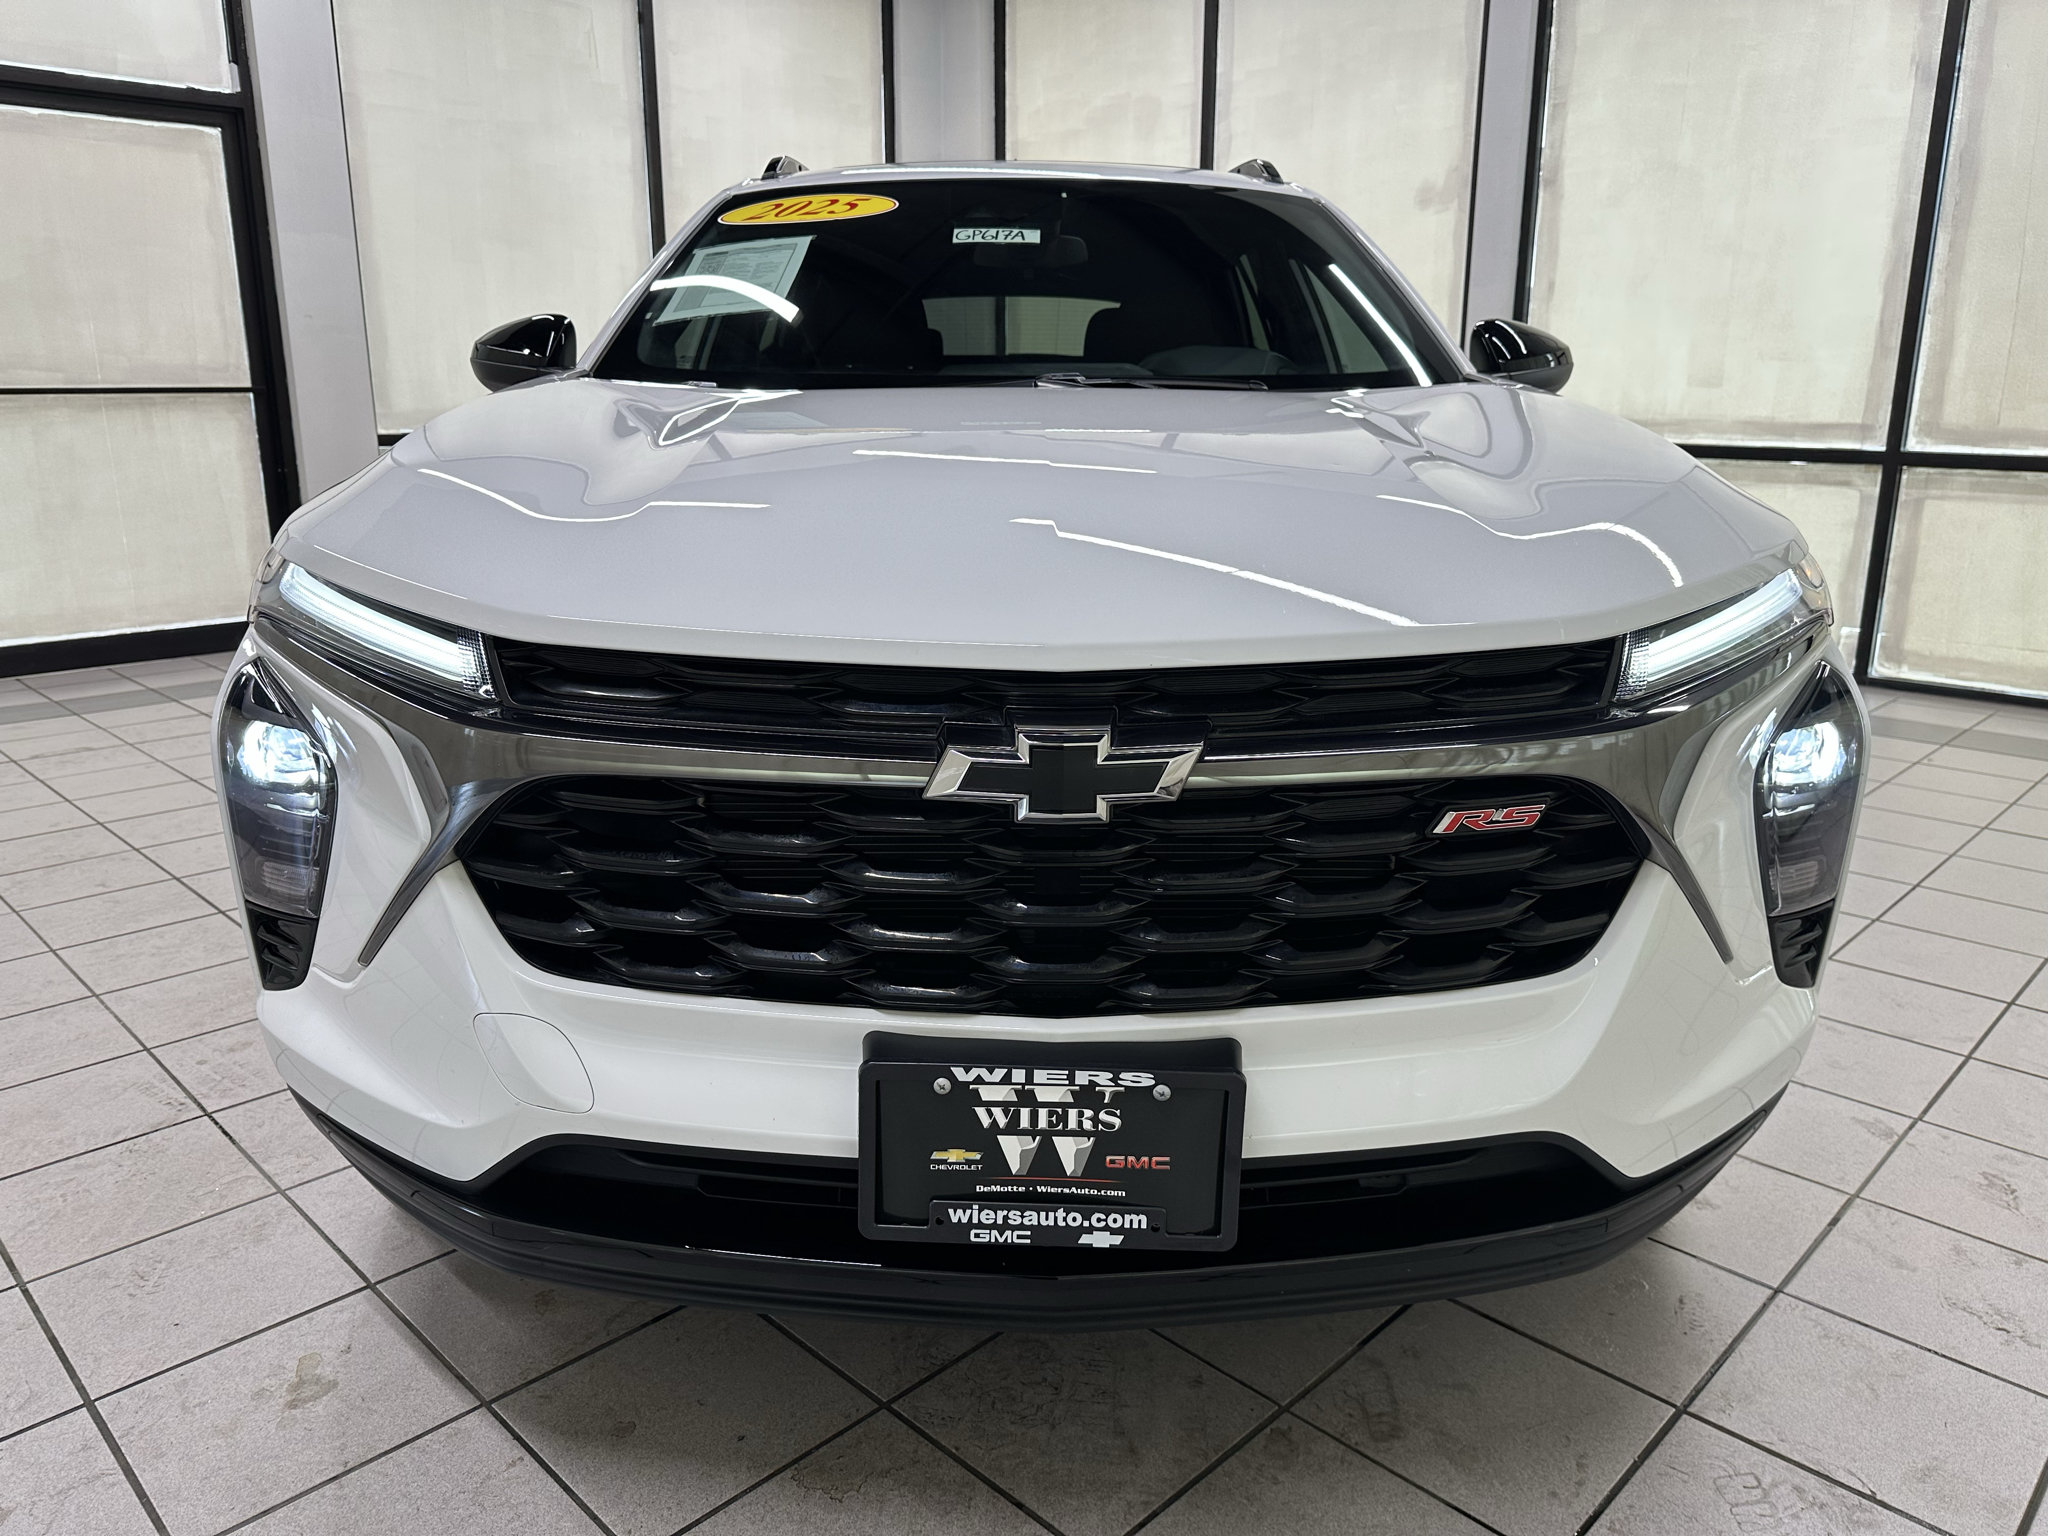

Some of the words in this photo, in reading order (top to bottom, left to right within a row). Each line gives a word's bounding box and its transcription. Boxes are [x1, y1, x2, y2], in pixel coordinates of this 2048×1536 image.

[742, 198, 872, 221] 2025
[955, 229, 1025, 241] GP617A
[1433, 805, 1545, 833] RS
[950, 1067, 1156, 1087] WIERS
[971, 1106, 1124, 1132] WIERS
[930, 1163, 983, 1171] CHEVROLET
[1105, 1155, 1171, 1170] GMC
[975, 1185, 1026, 1193] DeMotte
[1036, 1185, 1126, 1197] WiersAuto.com
[948, 1205, 1147, 1229] wiersauto.com
[969, 1229, 1031, 1243] GMC
